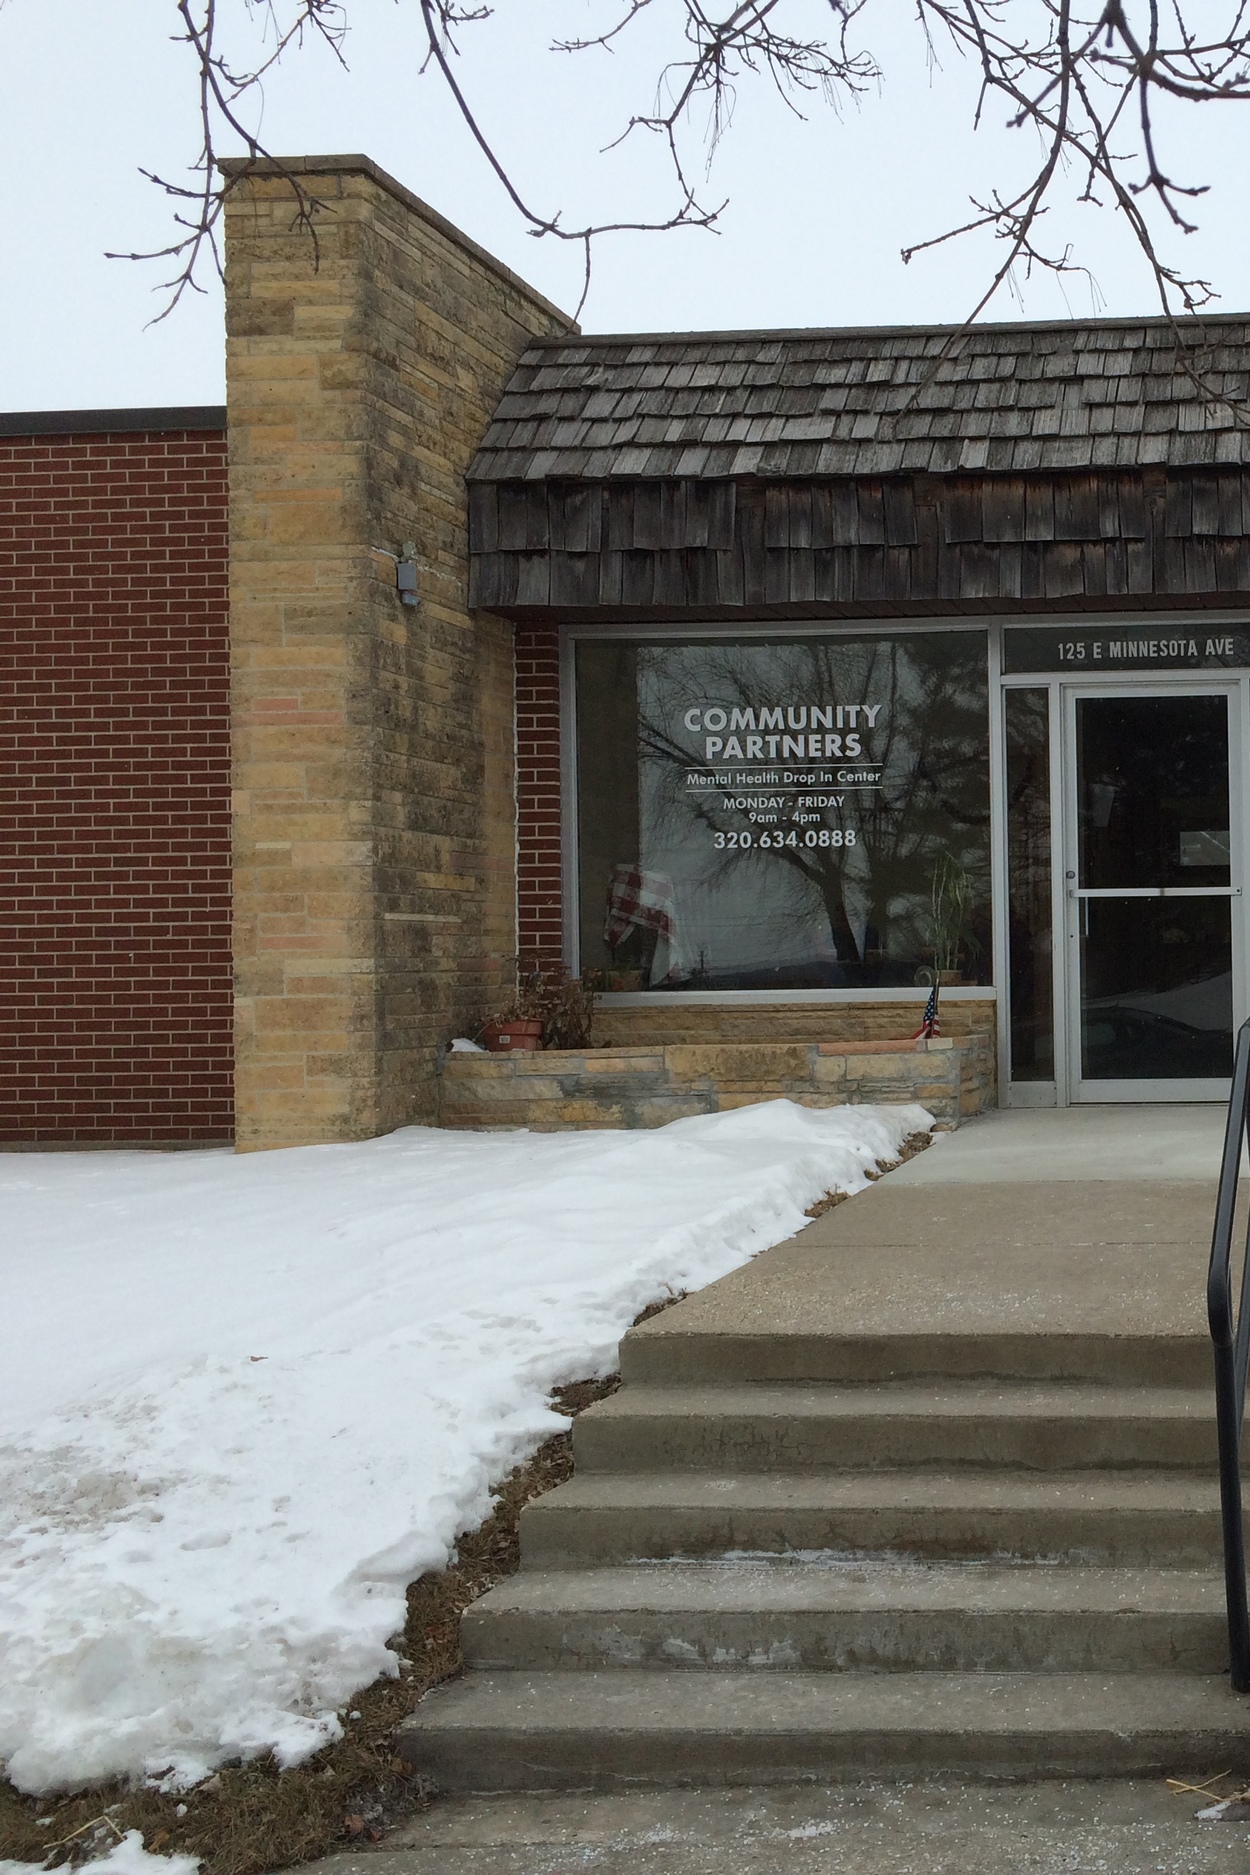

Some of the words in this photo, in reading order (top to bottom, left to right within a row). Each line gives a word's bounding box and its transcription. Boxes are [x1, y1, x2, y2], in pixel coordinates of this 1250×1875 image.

[1057, 642, 1086, 660] 125
[1093, 642, 1102, 659] E
[1109, 639, 1198, 658] MINNESOTA
[1205, 638, 1234, 656] AVE
[684, 704, 883, 732] COMMUNITY
[705, 733, 862, 760] PARTNERS
[687, 772, 732, 785] Mental
[736, 771, 779, 784] Health
[783, 771, 816, 785] Drop
[820, 771, 833, 782] In
[837, 770, 881, 782] Center
[723, 797, 785, 810] MONDAY
[798, 796, 845, 808] FRIDAY
[748, 812, 778, 824] 9am
[791, 812, 821, 825] 4pm
[713, 829, 856, 849] 320.634.0888
